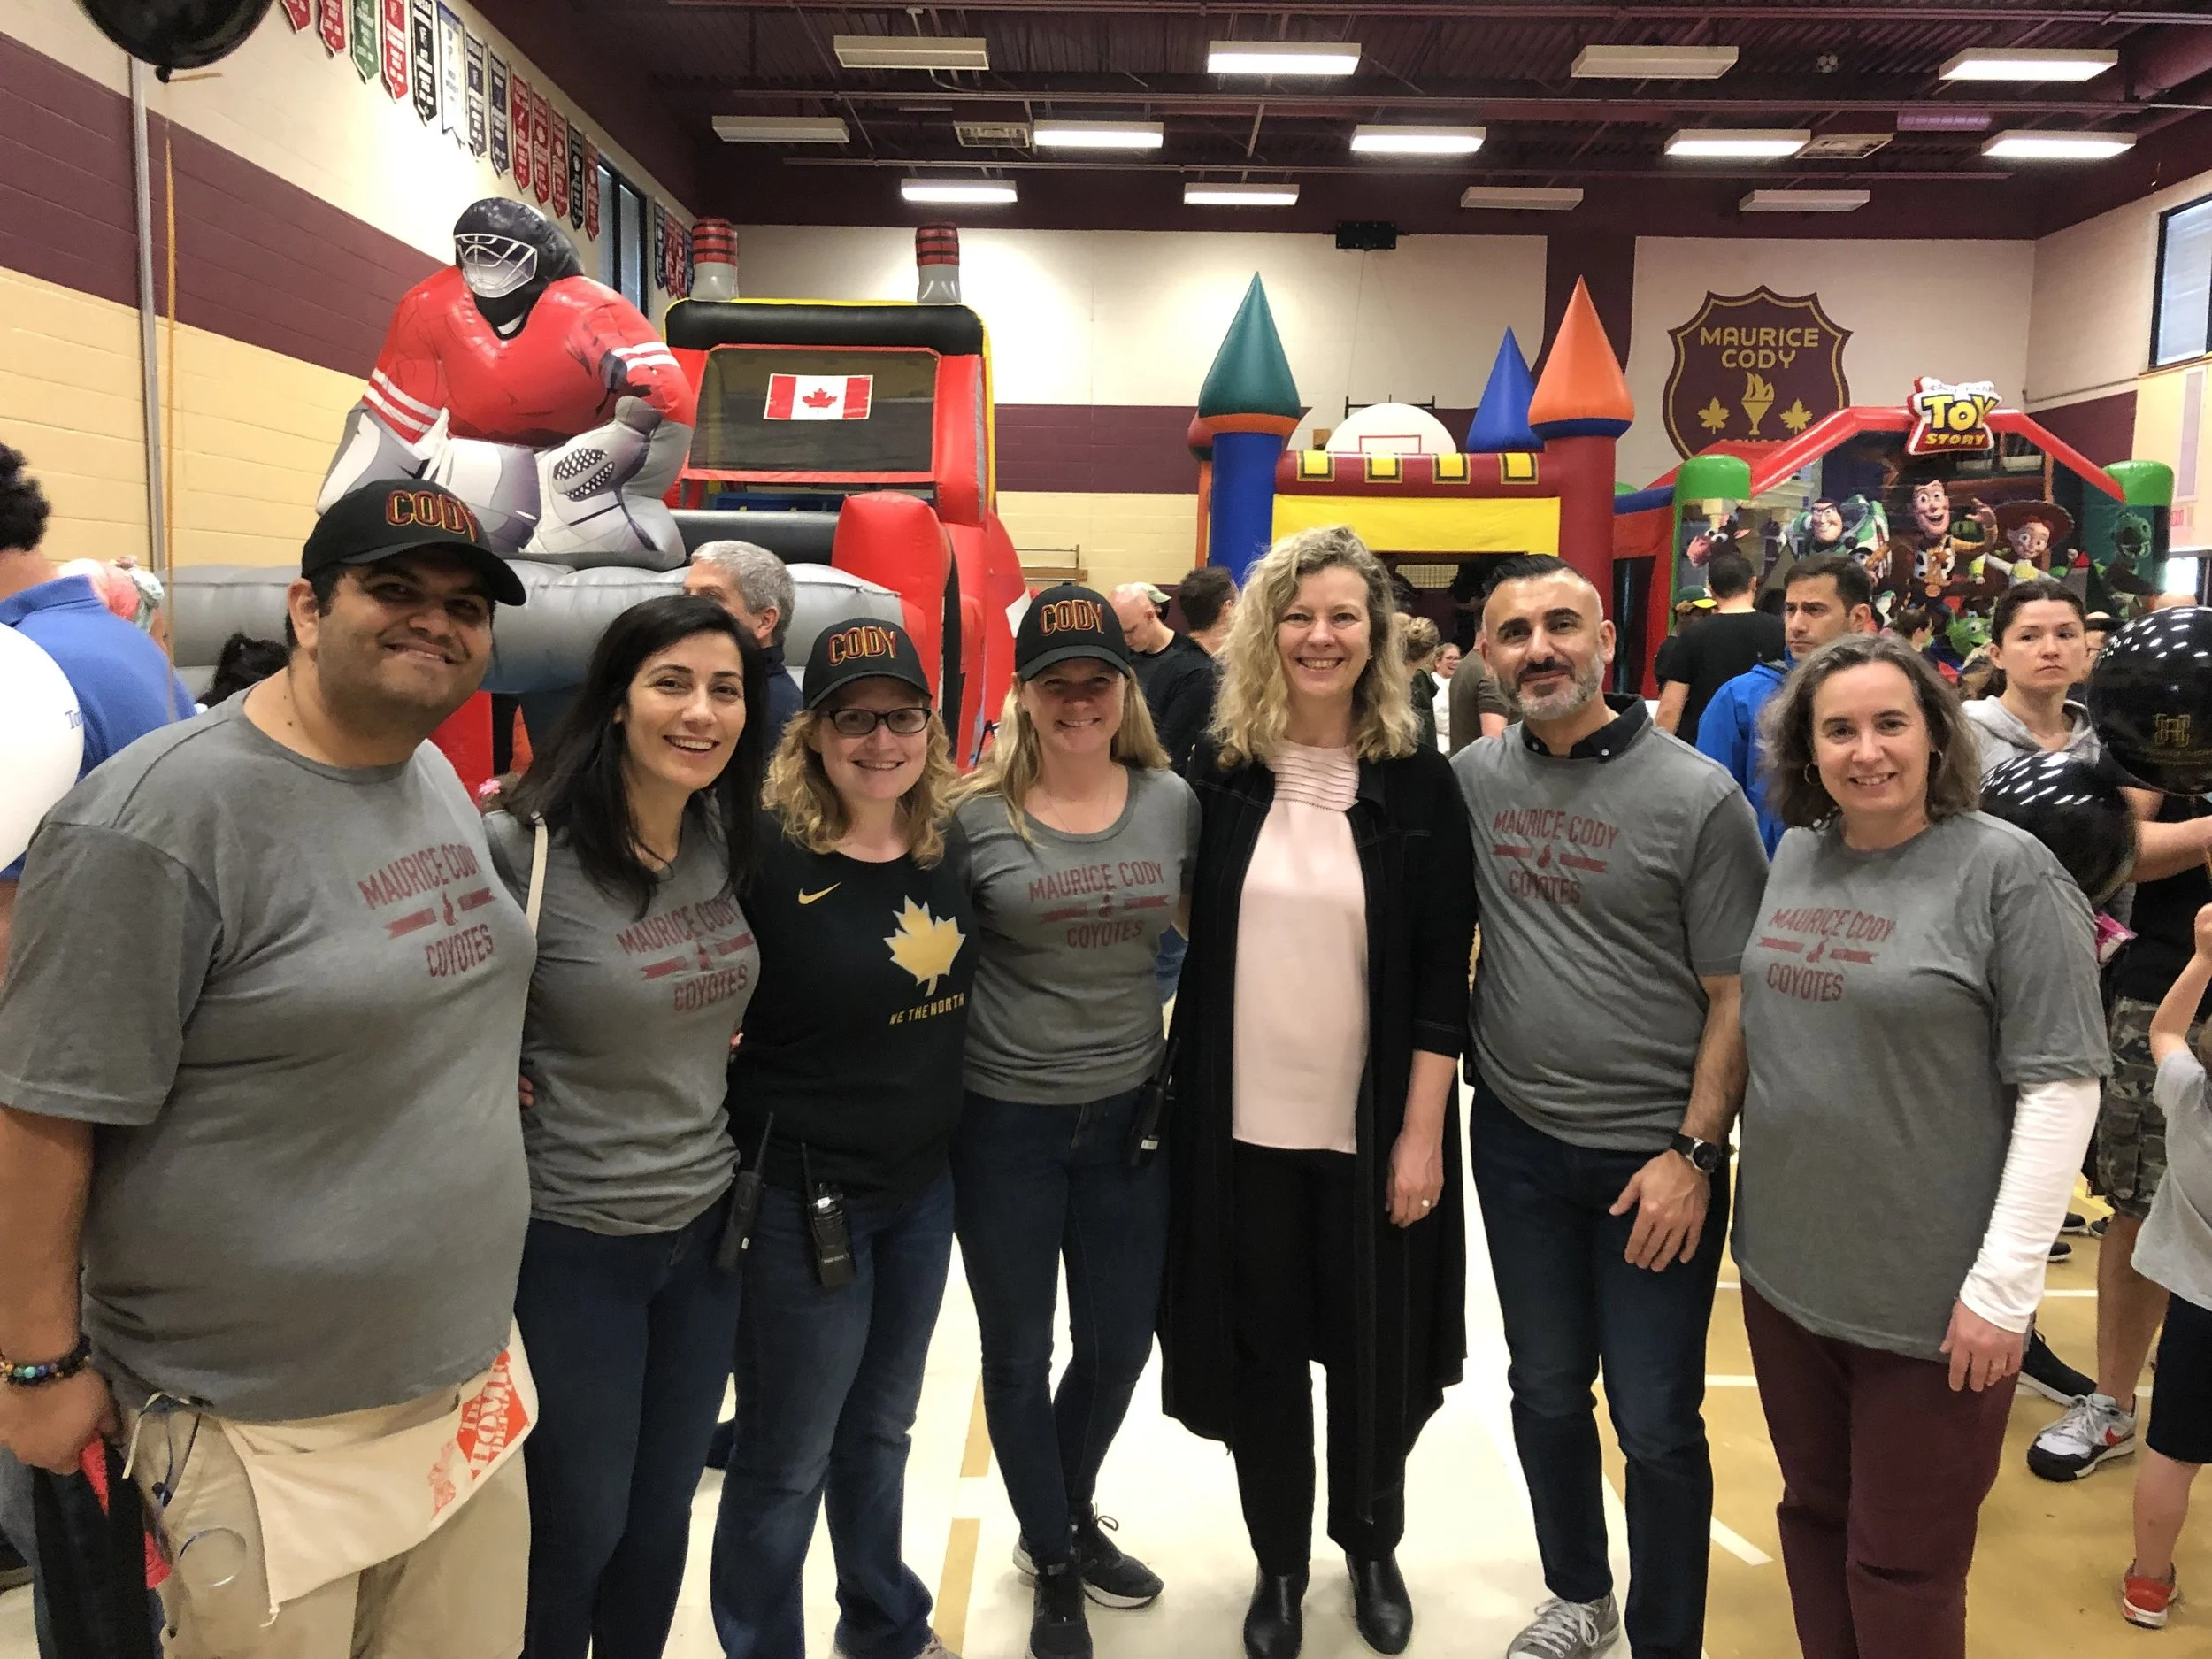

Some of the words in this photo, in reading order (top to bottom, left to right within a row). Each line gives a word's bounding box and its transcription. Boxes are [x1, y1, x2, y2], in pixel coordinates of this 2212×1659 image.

[1701, 327, 1820, 348] MAURICE
[1721, 349, 1796, 369] CODY
[1921, 393, 2000, 432] TOY
[1924, 433, 1985, 445] STORY
[1040, 599, 1105, 636] CODY
[828, 626, 898, 666] CODY
[1493, 808, 1566, 841] MAURICE
[1567, 815, 1619, 849] CODY
[357, 847, 449, 911] MAURICE
[1028, 863, 1117, 902] MAURICE
[1118, 860, 1165, 887] CODY
[616, 905, 702, 956] MAURICE
[1067, 920, 1145, 949] COYOTES
[1768, 909, 1853, 937] MAURICE
[1846, 910, 1897, 942] CODY
[425, 923, 494, 978] COYOTES
[673, 964, 748, 1012] COYOTES
[1767, 962, 1845, 1002] COYOTES
[909, 1004, 928, 1022] THE
[930, 992, 964, 1016] NORTH
